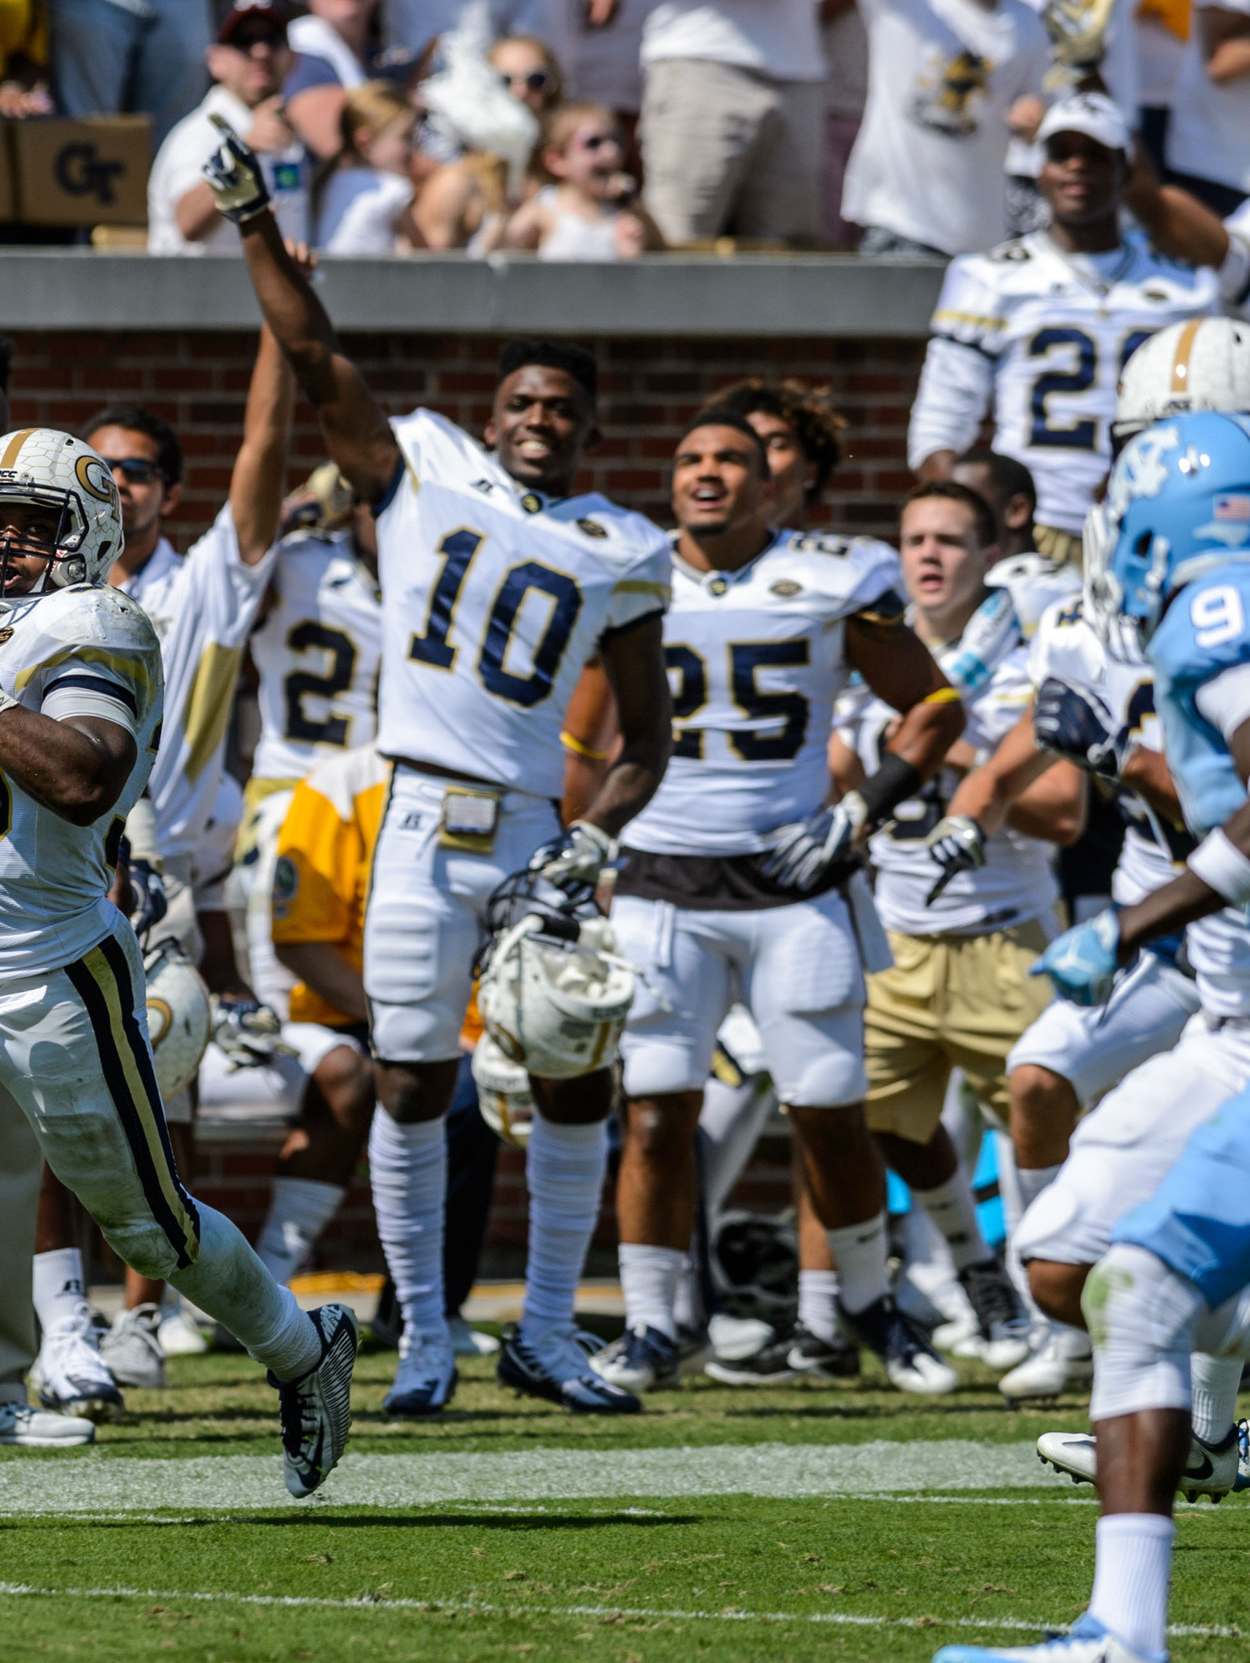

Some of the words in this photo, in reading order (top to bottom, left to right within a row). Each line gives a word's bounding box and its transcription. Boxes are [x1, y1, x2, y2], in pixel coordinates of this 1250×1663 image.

[1027, 323, 1152, 451] 2
[406, 525, 585, 710] 10
[1189, 584, 1244, 649] 9
[663, 637, 812, 763] 25
